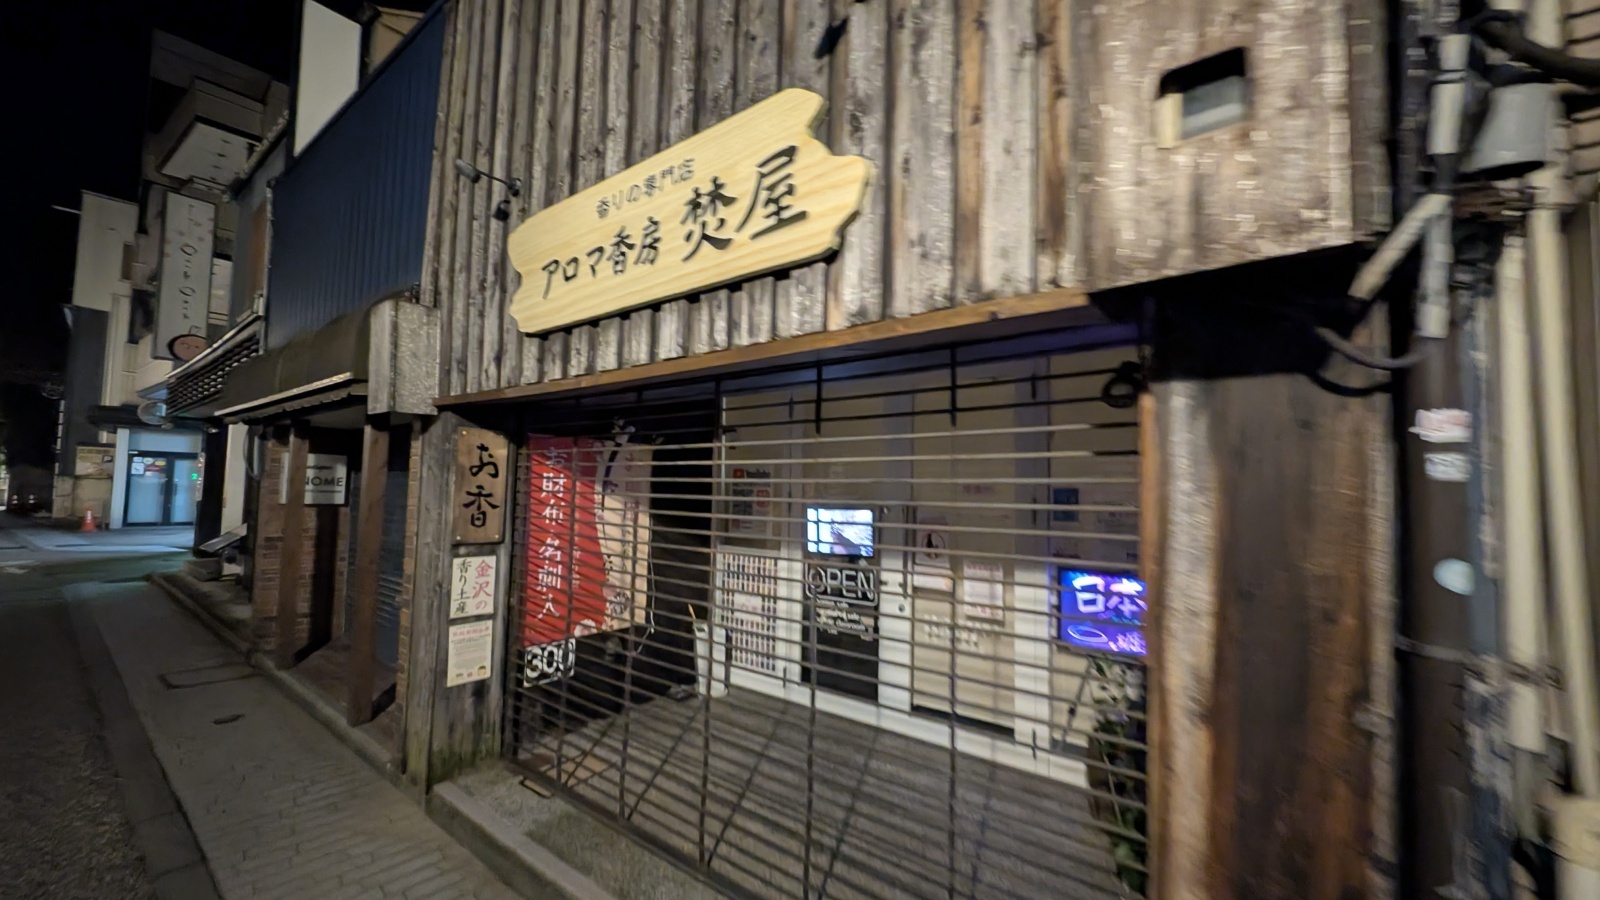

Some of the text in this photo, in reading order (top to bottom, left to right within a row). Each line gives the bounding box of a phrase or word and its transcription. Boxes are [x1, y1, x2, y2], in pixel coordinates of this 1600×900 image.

[595, 158, 696, 219] 香りの専門店
[541, 145, 807, 300] アロマ香房 焚屋
[462, 443, 500, 528] お香
[453, 558, 472, 616] 香り土産
[472, 559, 494, 610] 金沢の
[809, 567, 875, 600] OPEN
